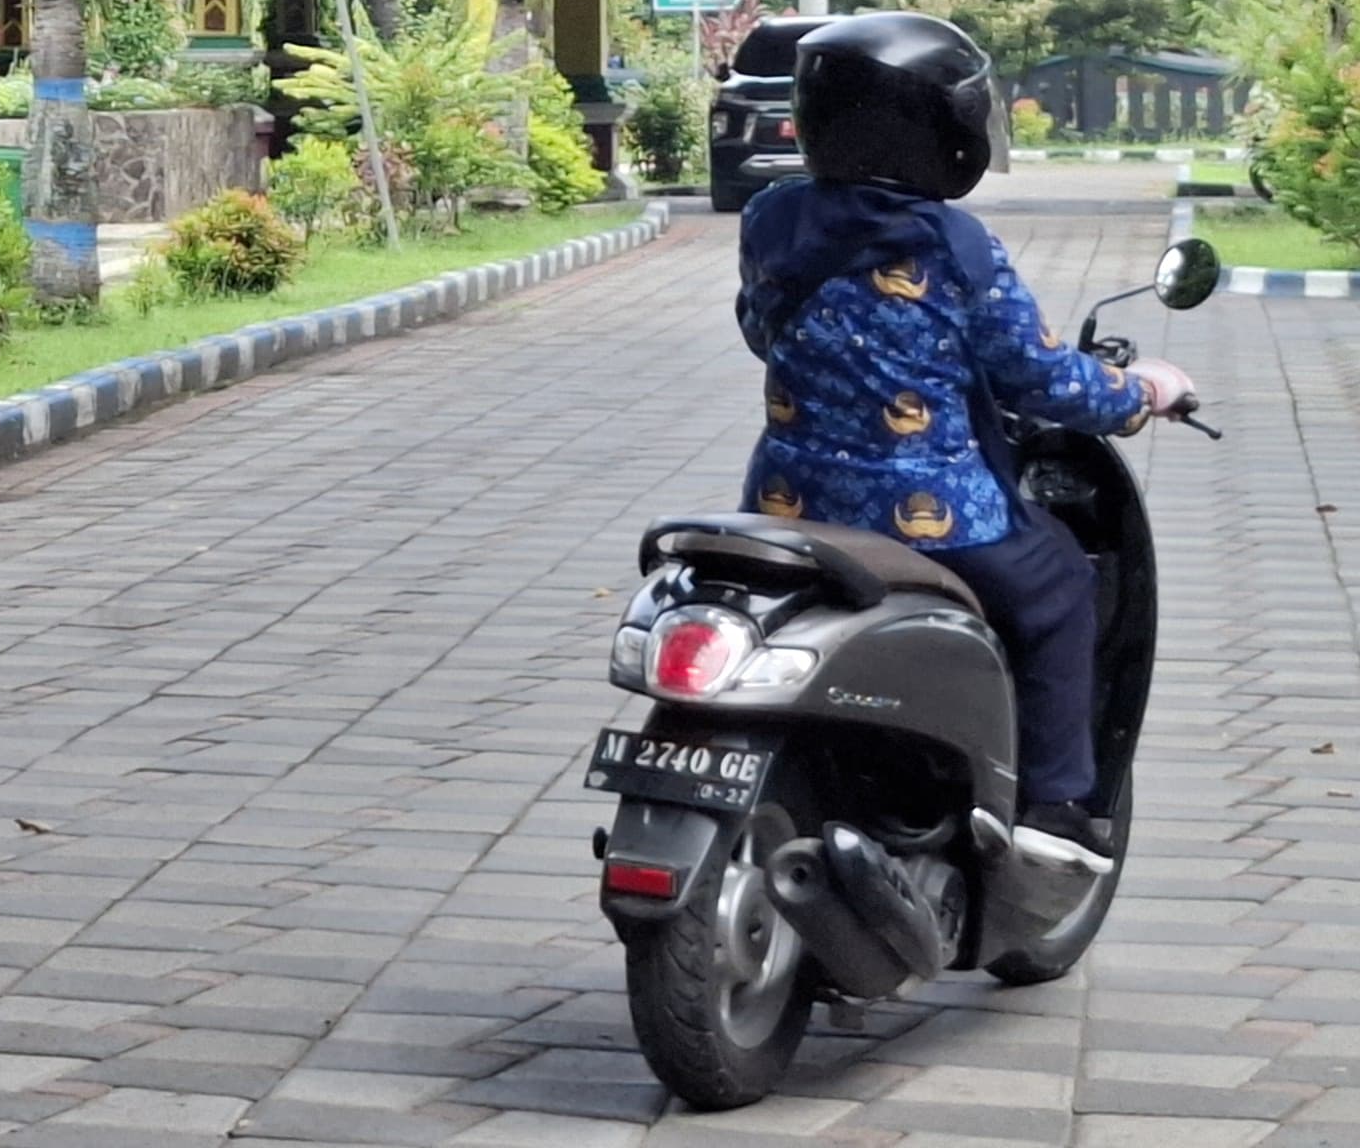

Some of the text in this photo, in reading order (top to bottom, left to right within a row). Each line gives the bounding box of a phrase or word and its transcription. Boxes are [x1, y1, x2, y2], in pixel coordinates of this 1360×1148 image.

[600, 732, 762, 782] M 2740 GE
